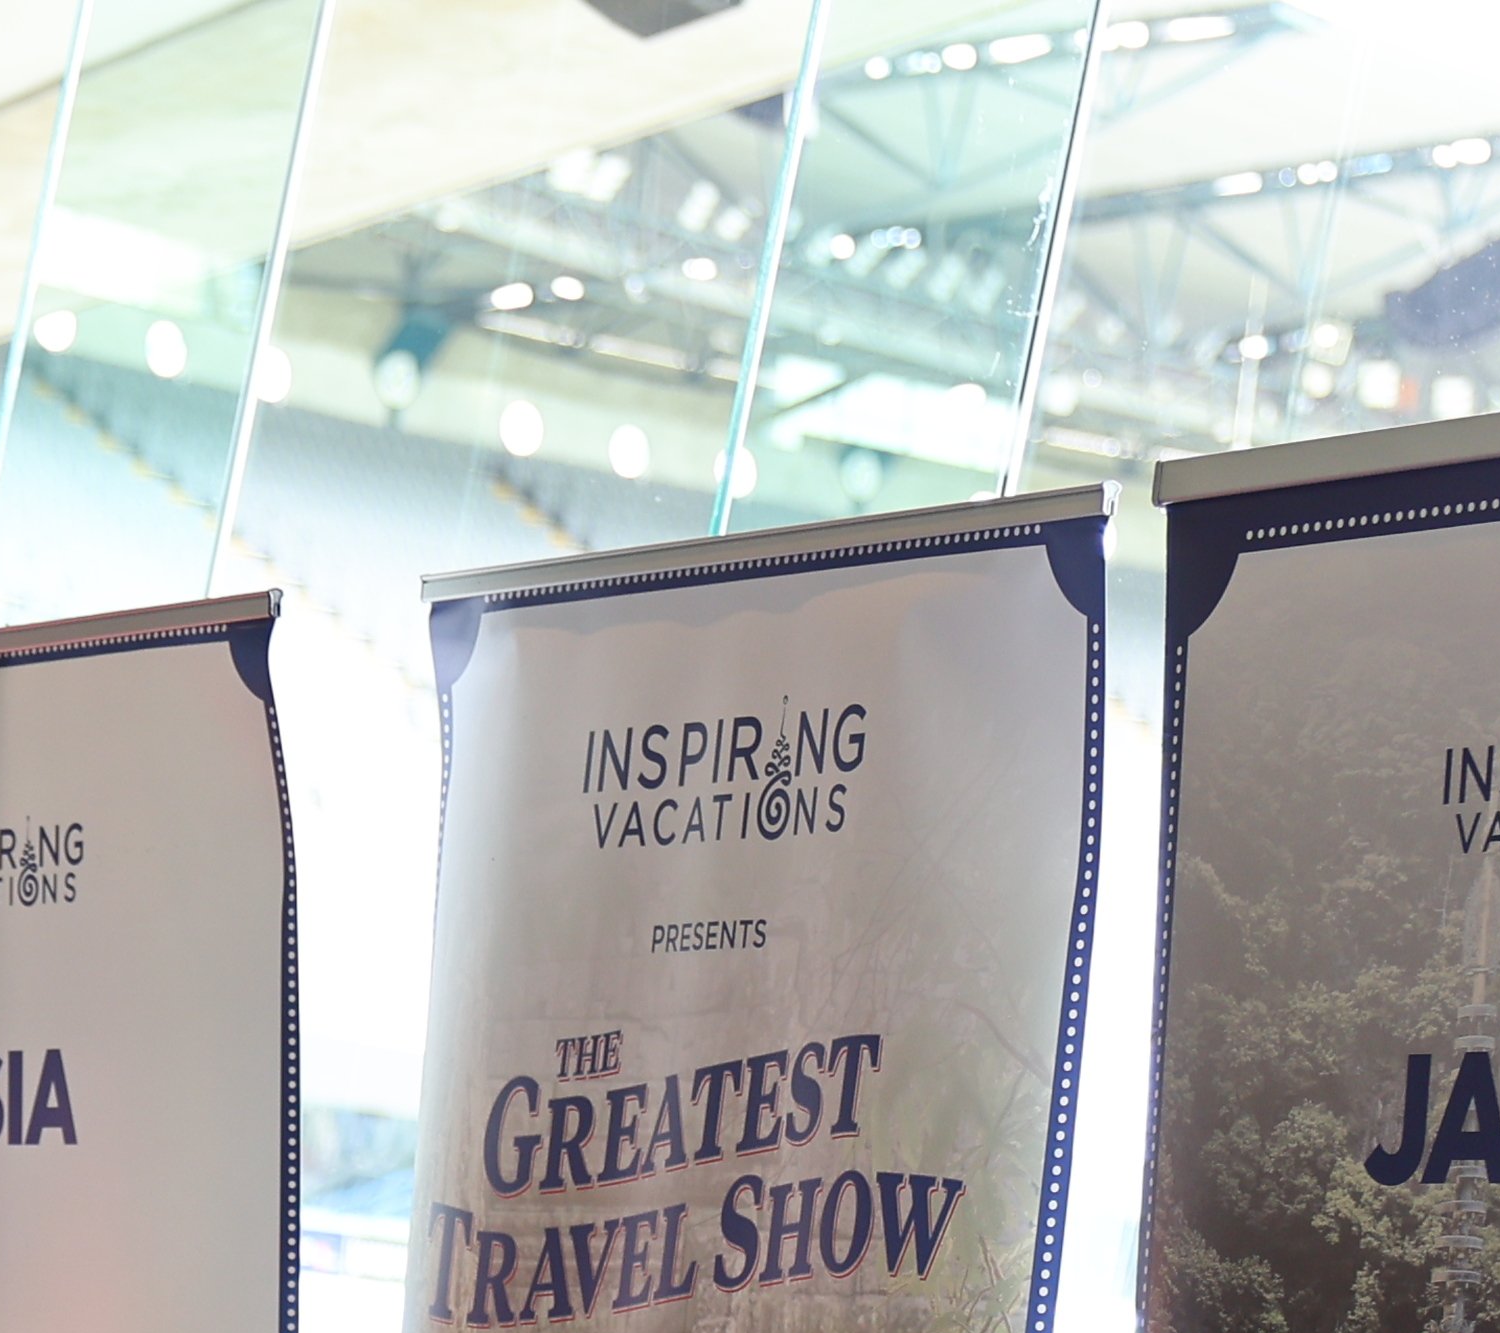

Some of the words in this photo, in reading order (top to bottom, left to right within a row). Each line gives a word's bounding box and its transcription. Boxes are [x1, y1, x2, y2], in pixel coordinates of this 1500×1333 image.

[582, 695, 868, 794] INSPIRING
[593, 776, 848, 849] VACATIONS
[650, 918, 768, 954] PRESENTS
[555, 1029, 623, 1083] THE
[483, 1034, 883, 1199] GREATEST
[428, 1201, 700, 1329] TRAVEL
[712, 1167, 966, 1295] SHOW
